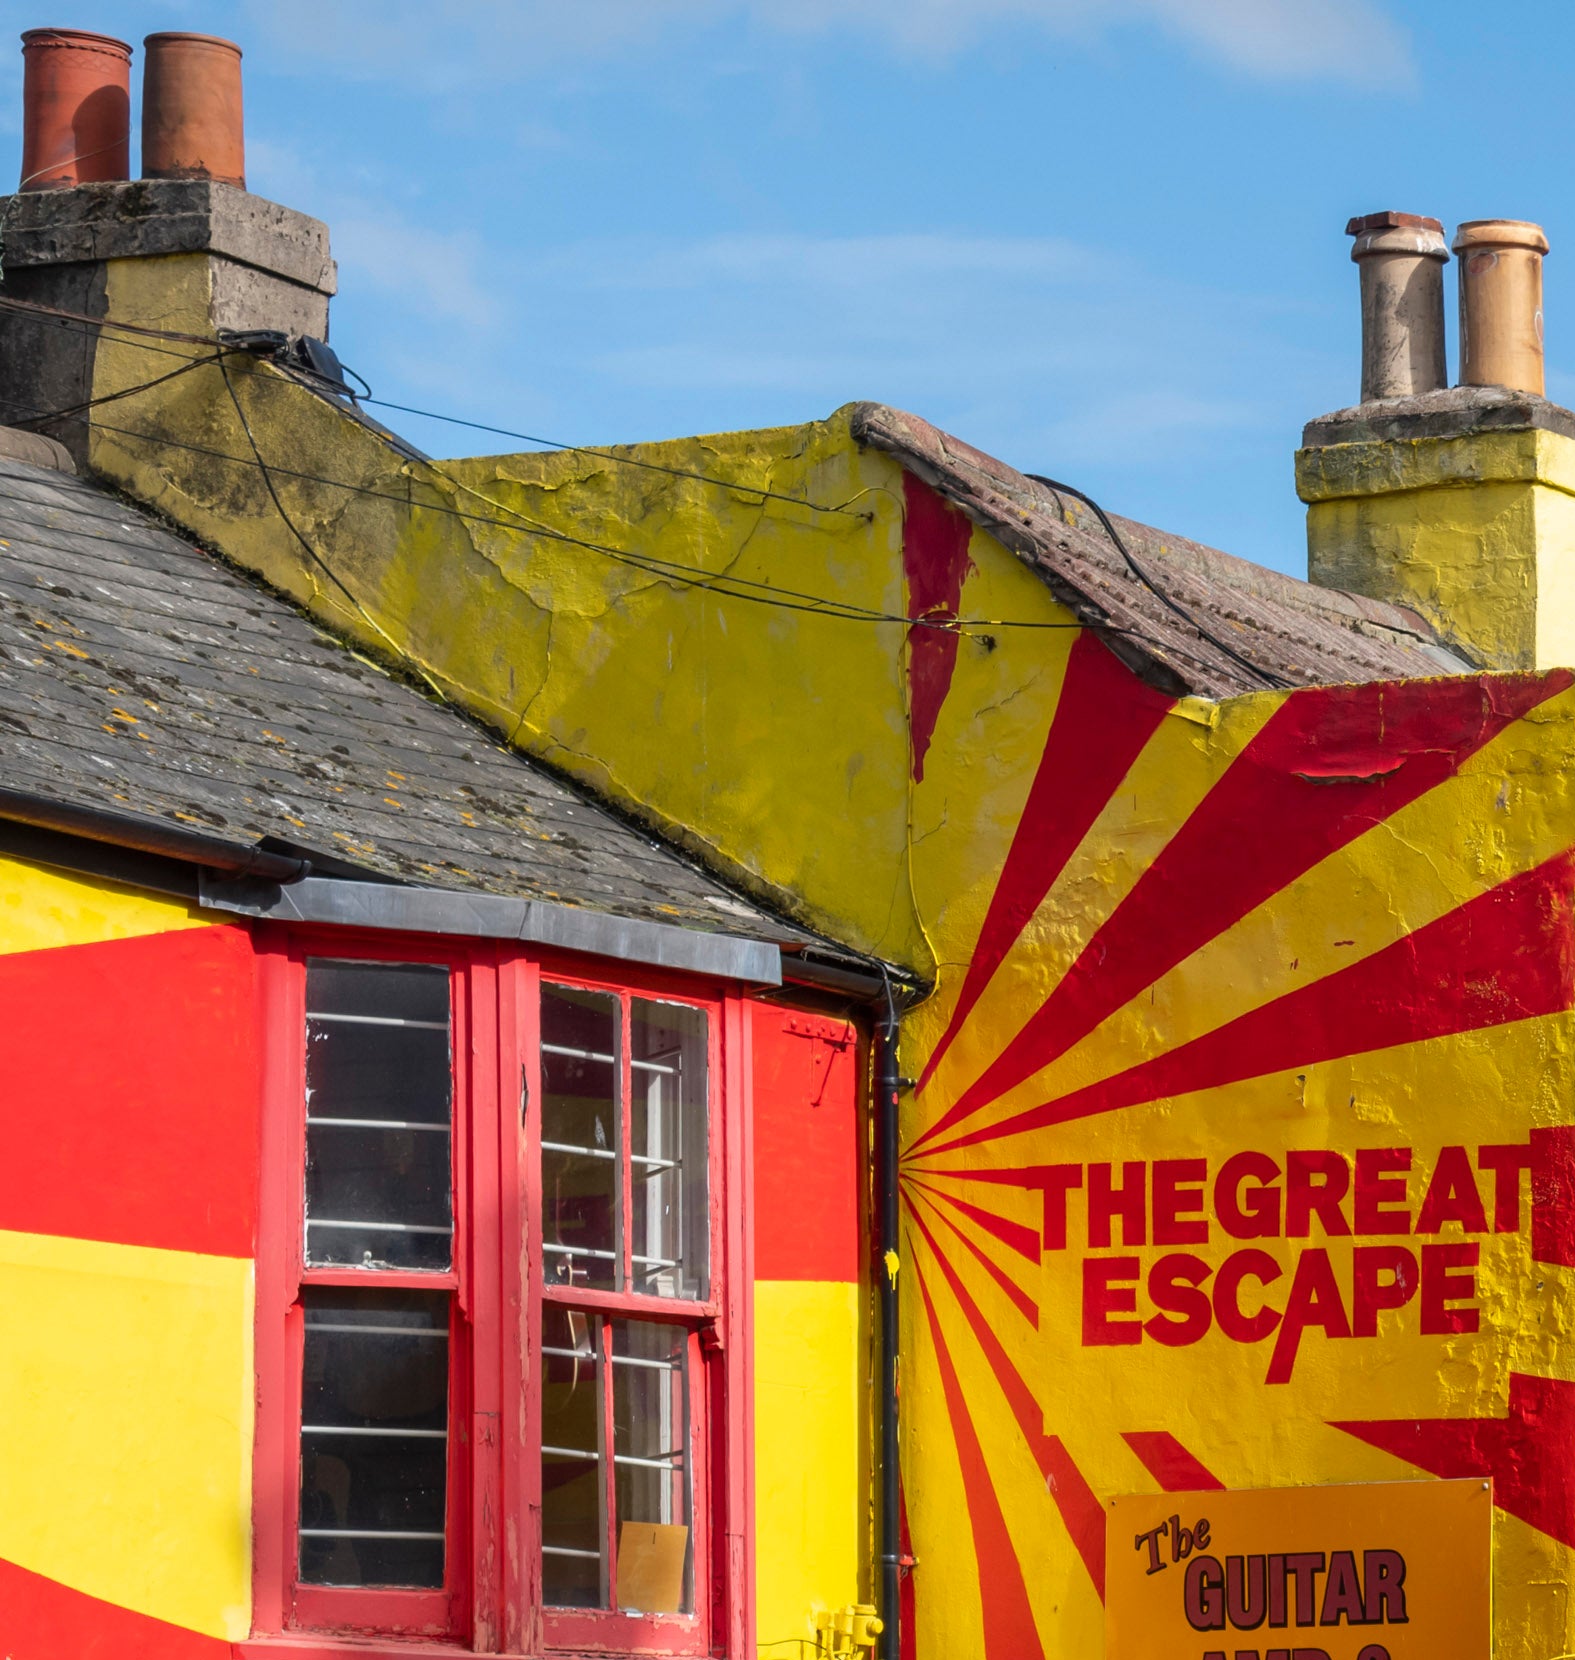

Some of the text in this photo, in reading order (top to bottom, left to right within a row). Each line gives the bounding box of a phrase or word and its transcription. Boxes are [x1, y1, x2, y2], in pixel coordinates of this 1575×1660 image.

[1025, 1143, 1531, 1251] THE GREAT
[1081, 1242, 1480, 1384] ESCAPE
[1134, 1513, 1211, 1576] The
[1184, 1548, 1410, 1632] GUITAR
